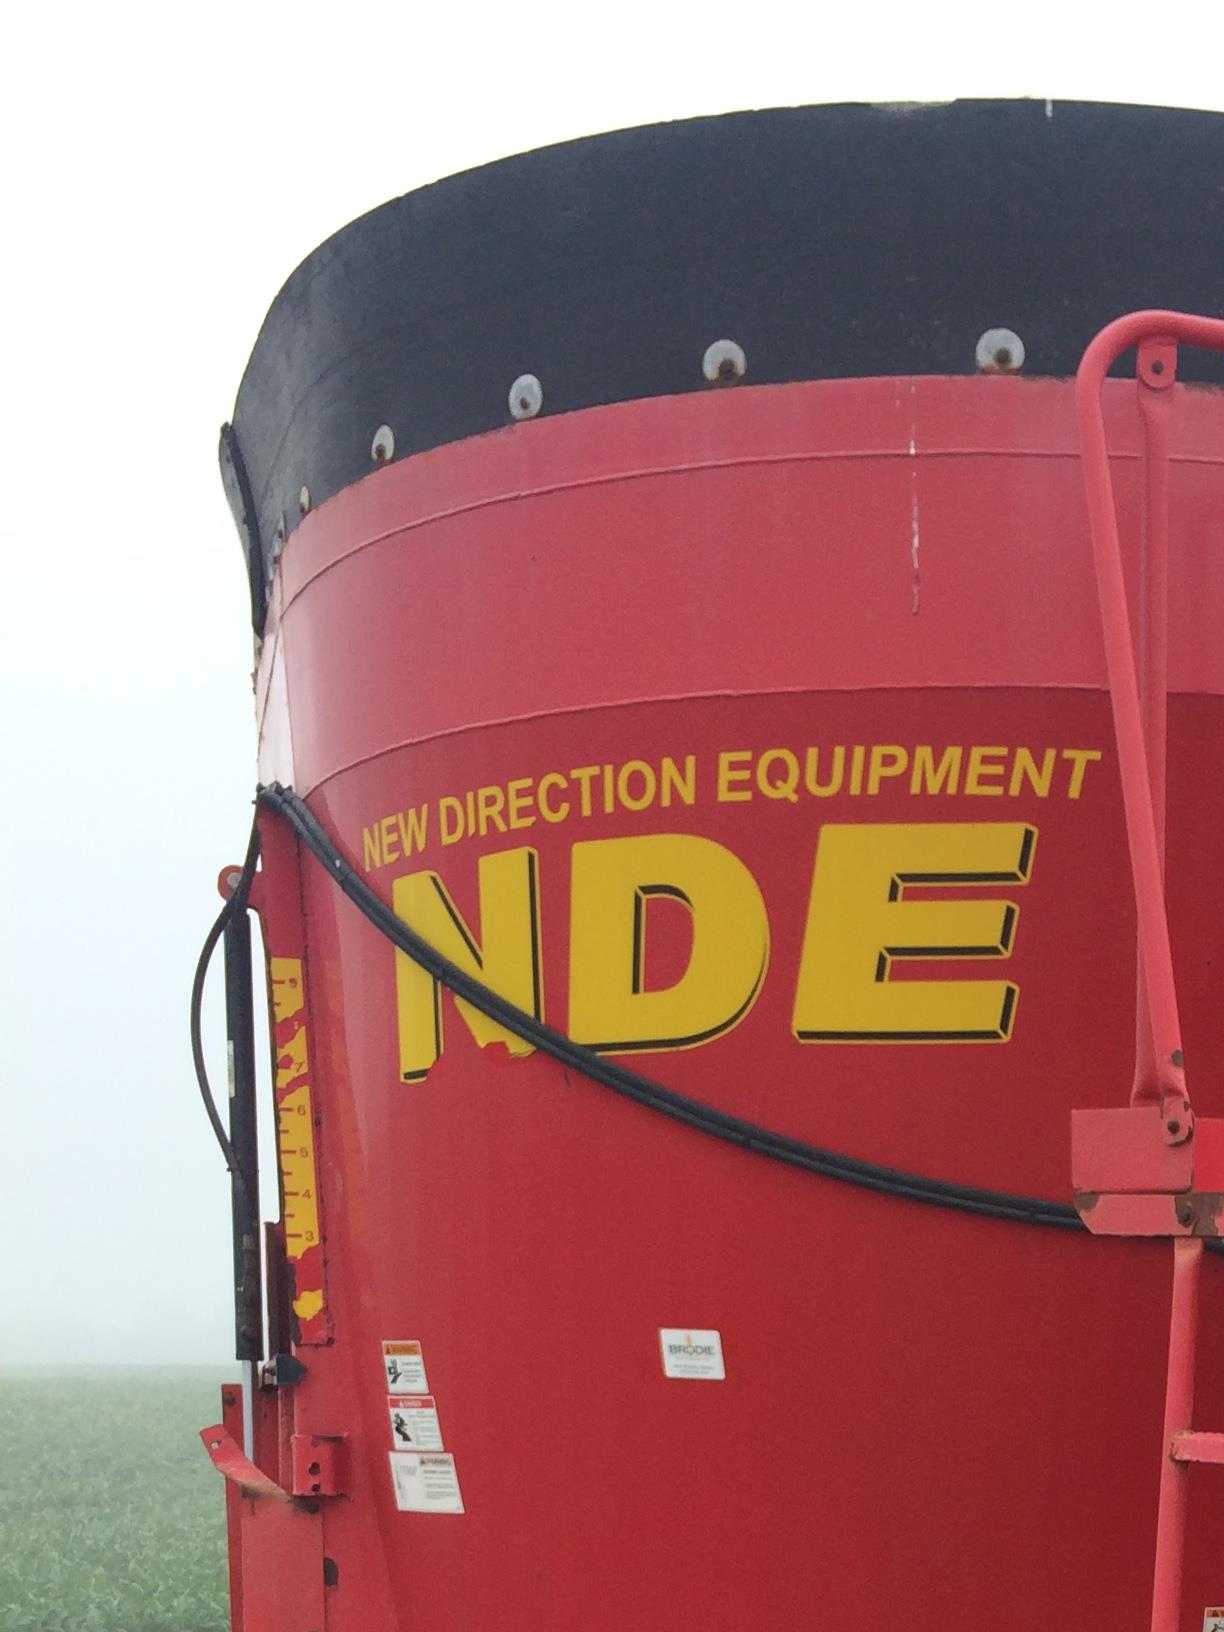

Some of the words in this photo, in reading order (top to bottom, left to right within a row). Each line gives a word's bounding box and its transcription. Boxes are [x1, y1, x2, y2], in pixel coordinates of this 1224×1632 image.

[362, 801, 429, 872] NEW
[438, 755, 697, 847] DIRECTION
[717, 744, 1102, 802] EQUIPMENT
[390, 822, 1039, 1084] NDE
[296, 1104, 307, 1116] 6
[299, 1146, 309, 1159] 5
[302, 1188, 312, 1200] 4
[305, 1230, 315, 1242] 3
